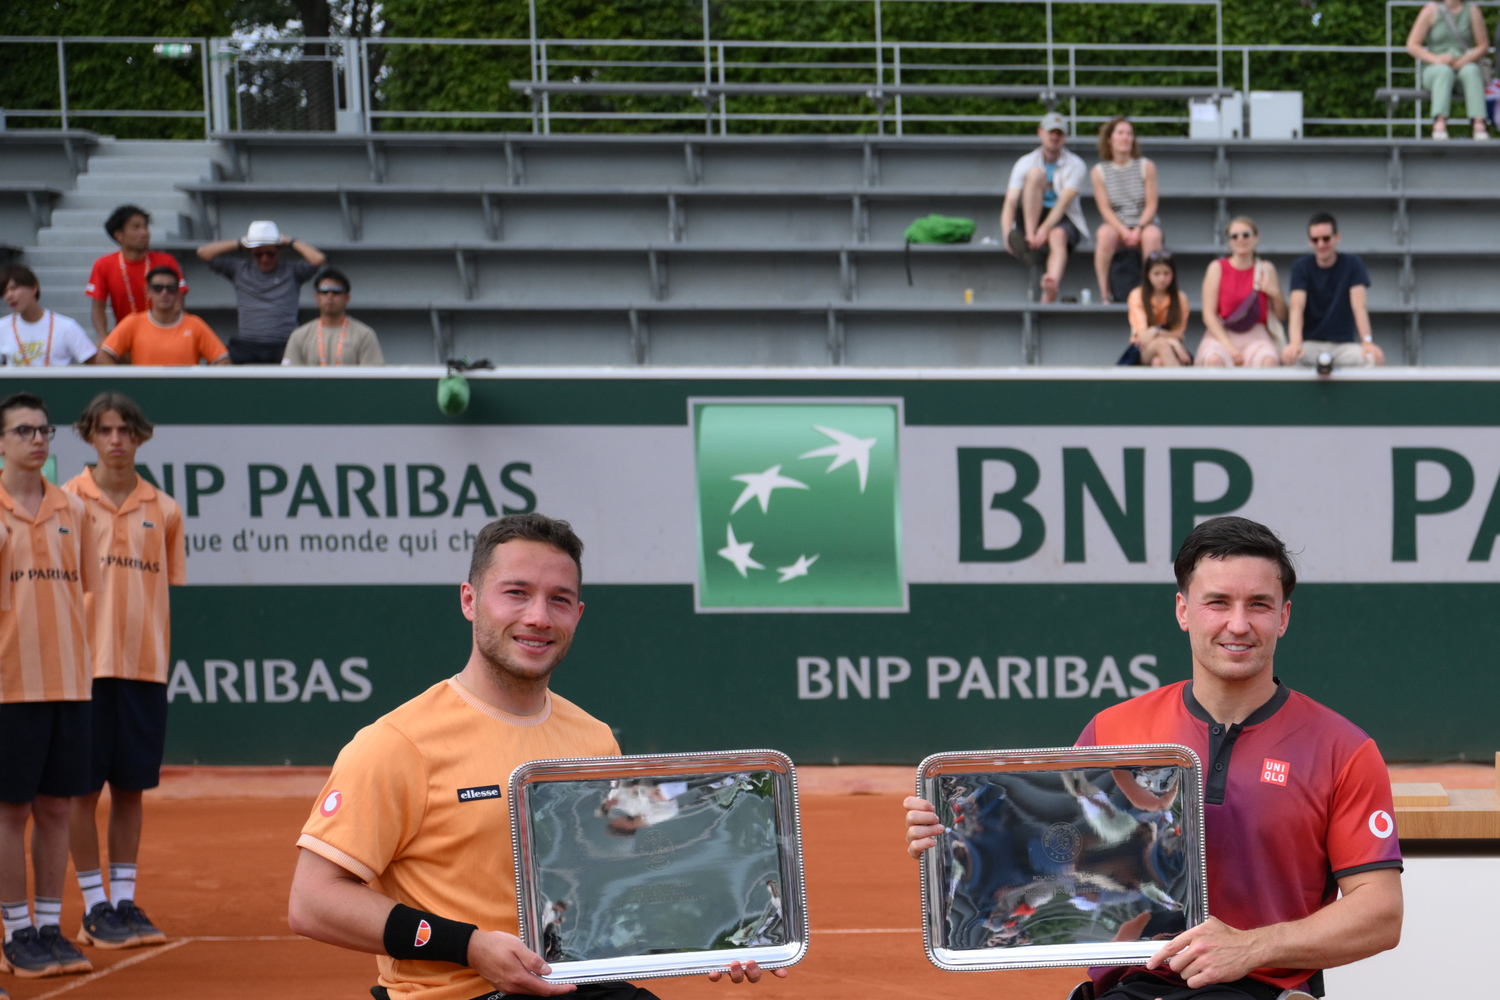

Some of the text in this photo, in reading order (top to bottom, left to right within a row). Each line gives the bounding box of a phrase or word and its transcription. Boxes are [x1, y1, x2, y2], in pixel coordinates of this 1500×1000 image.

[135, 461, 541, 518] NP PARIBAS
[957, 447, 1253, 562] BNP
[232, 529, 289, 551] d'un
[300, 530, 389, 551] monde
[399, 529, 438, 557] qui
[168, 659, 373, 702] ARIBAS
[798, 655, 1160, 698] BNP PARIBAS
[1263, 771, 1285, 783] QLO
[1265, 761, 1285, 773] UNI
[460, 788, 499, 799] ellesse
